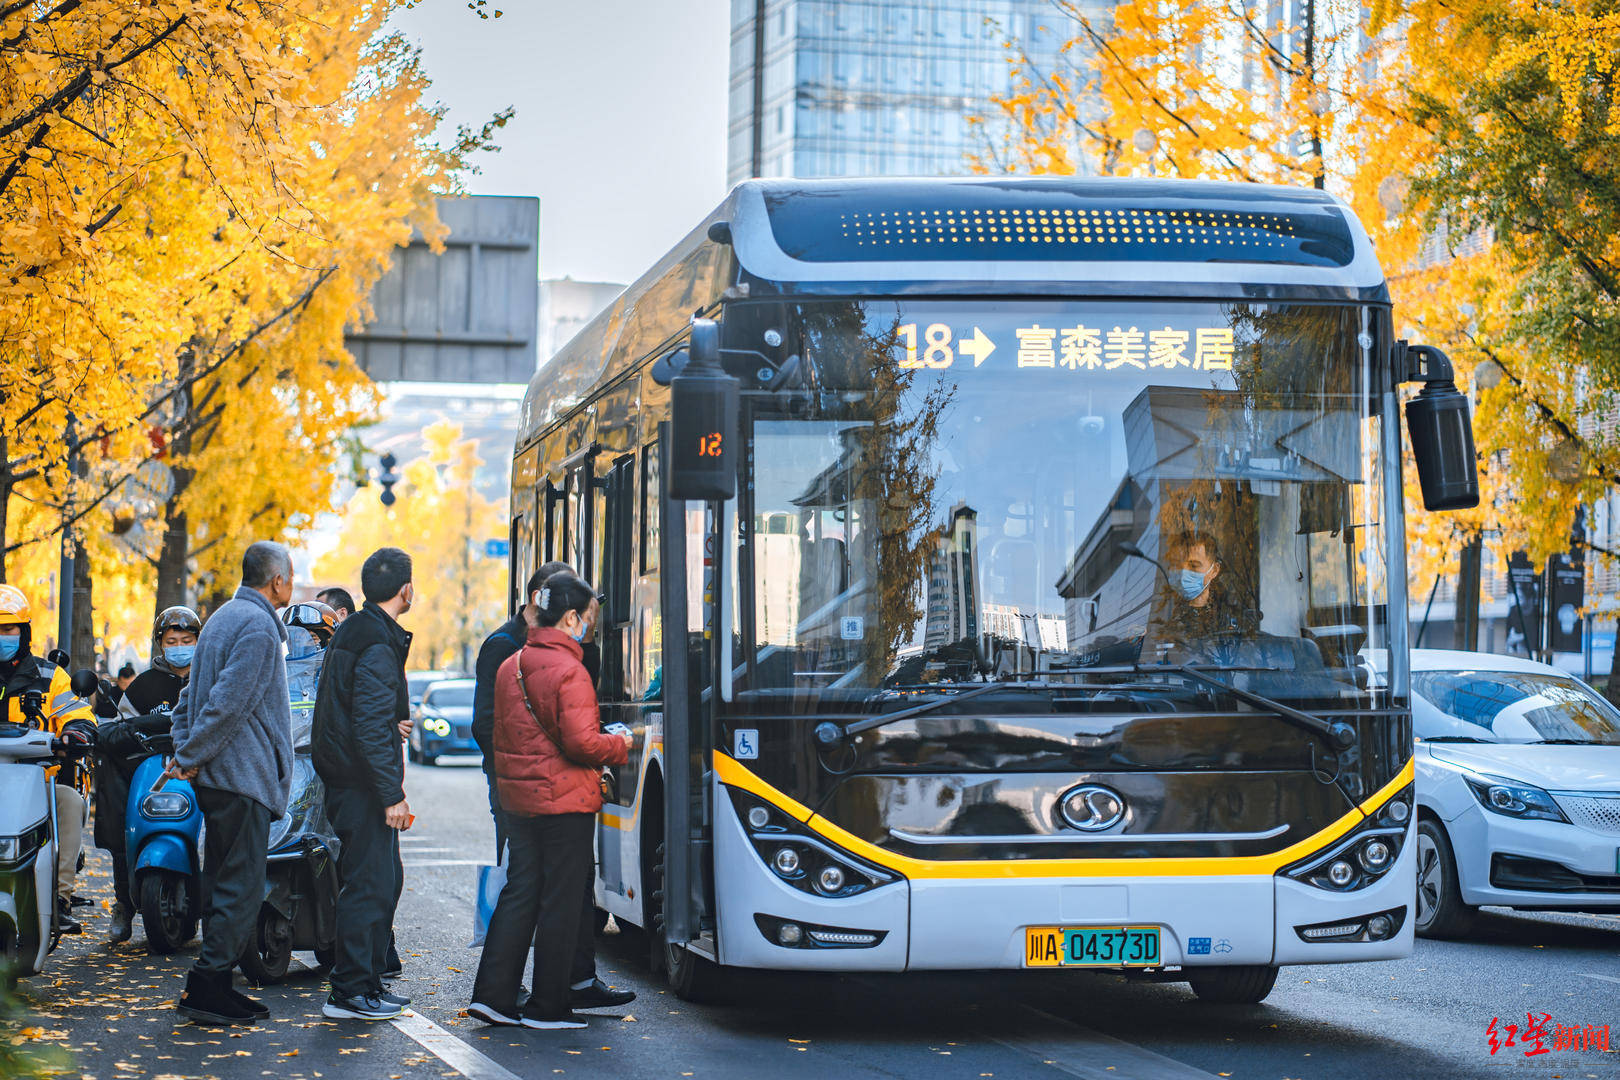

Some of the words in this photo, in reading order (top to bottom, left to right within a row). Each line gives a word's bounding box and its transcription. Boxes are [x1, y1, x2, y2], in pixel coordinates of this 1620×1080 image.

[896, 323, 955, 369] 18
[1015, 324, 1235, 371] 富森美家居
[1029, 934, 1058, 961] 川A
[1070, 933, 1158, 961] 04373D
